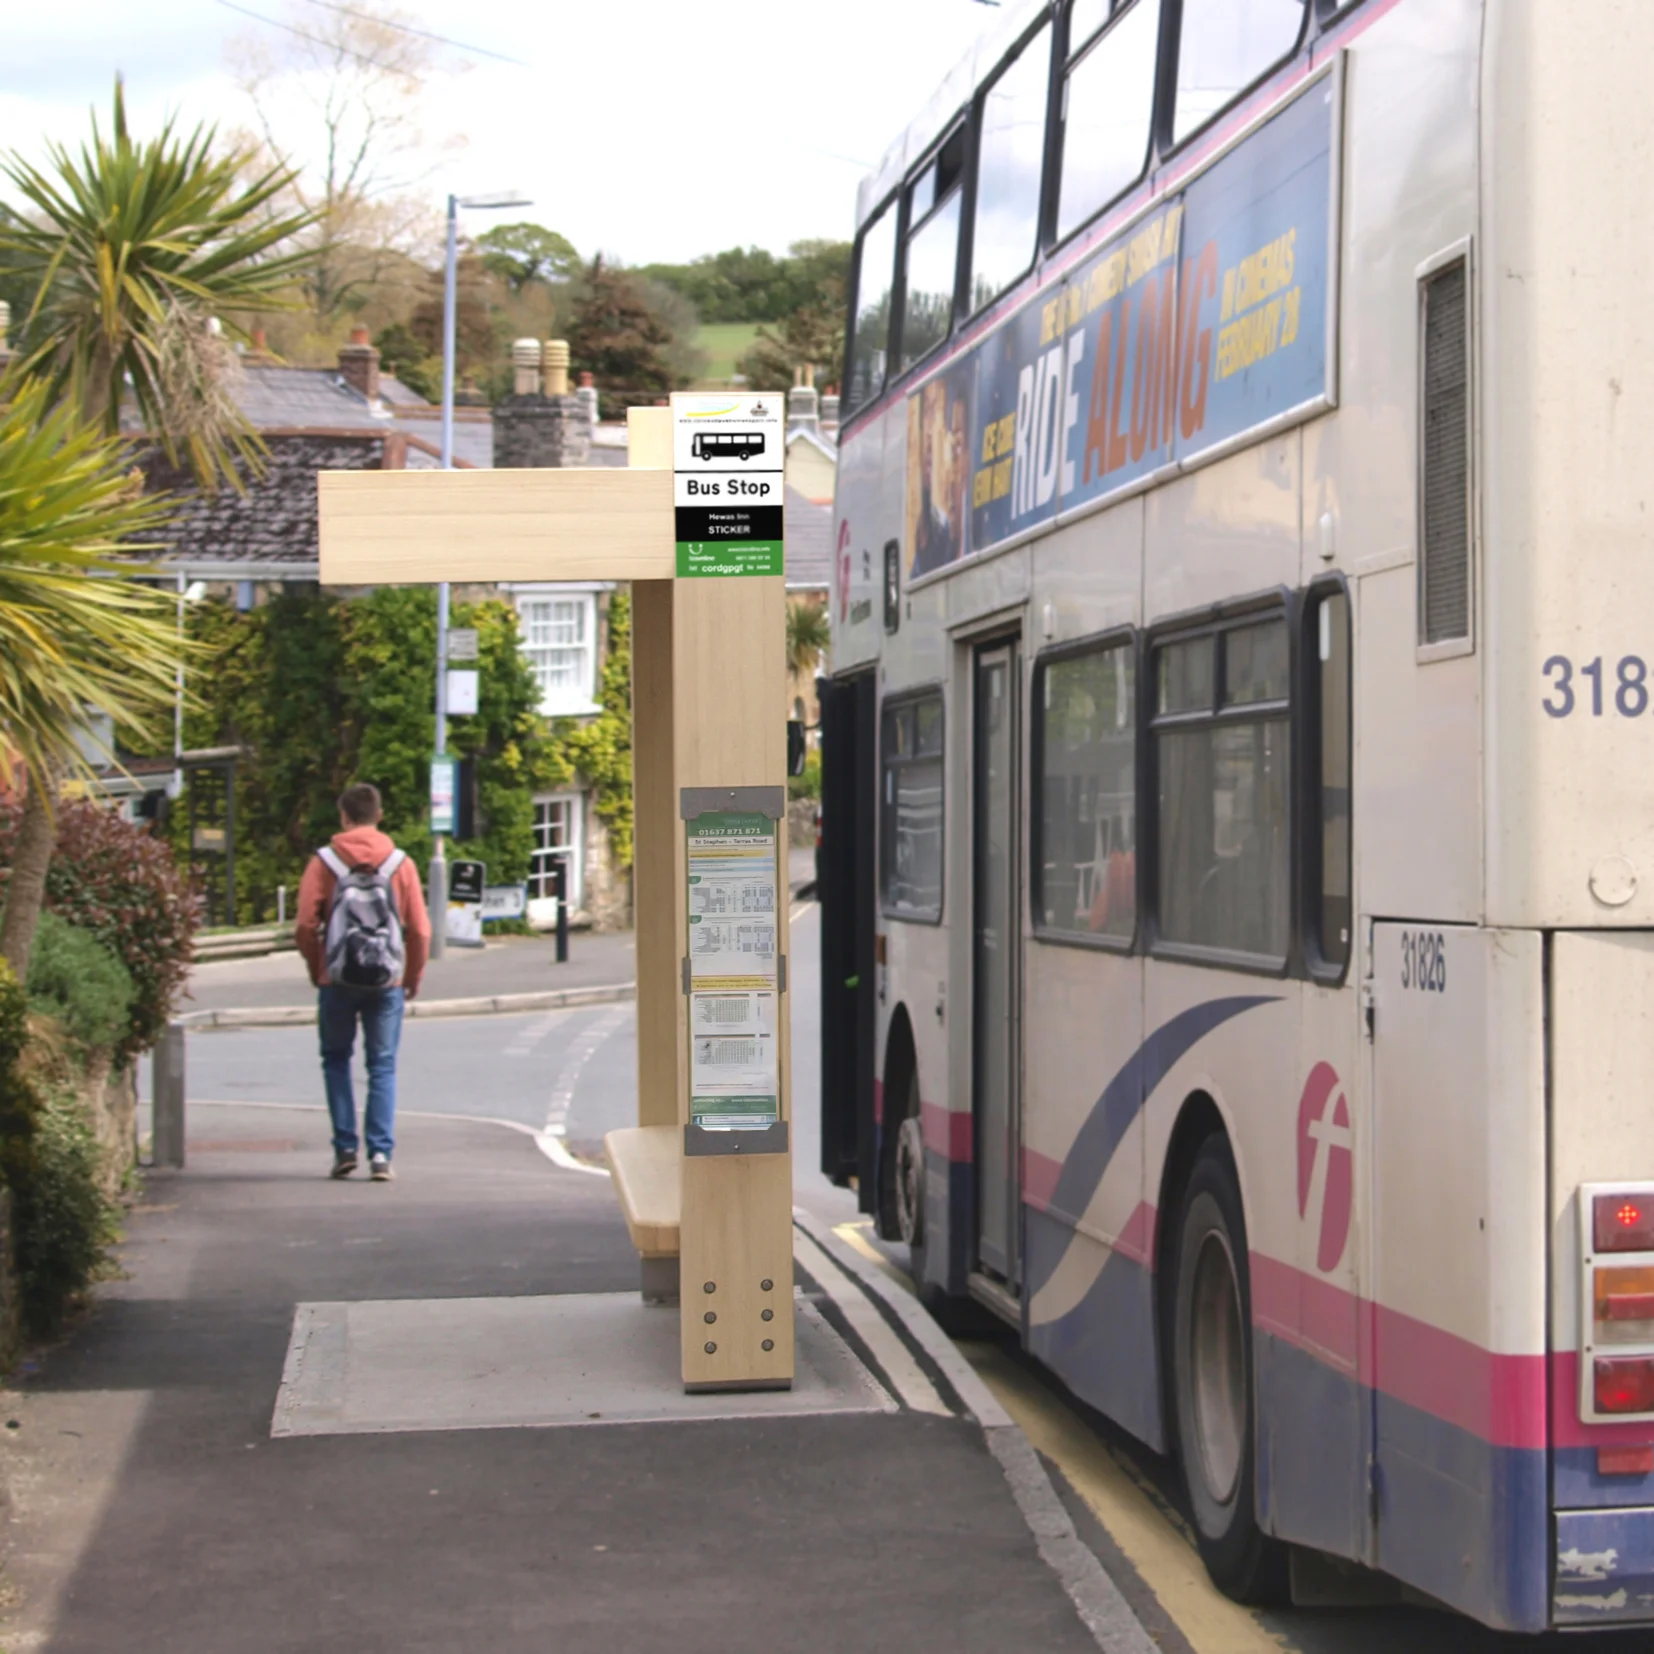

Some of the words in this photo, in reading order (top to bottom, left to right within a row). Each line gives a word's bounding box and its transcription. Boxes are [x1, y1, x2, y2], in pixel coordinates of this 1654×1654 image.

[1236, 226, 1296, 314] CINEMAS
[1214, 296, 1283, 383] FEBRUARY
[1011, 328, 1085, 520] RIDE
[1083, 239, 1219, 486] ALONG
[687, 479, 720, 496] Bus
[727, 479, 771, 498] Stop
[708, 525, 751, 535] STICKER
[1542, 654, 1654, 718] 318
[745, 827, 761, 835] 871
[1401, 930, 1446, 994] 31826
